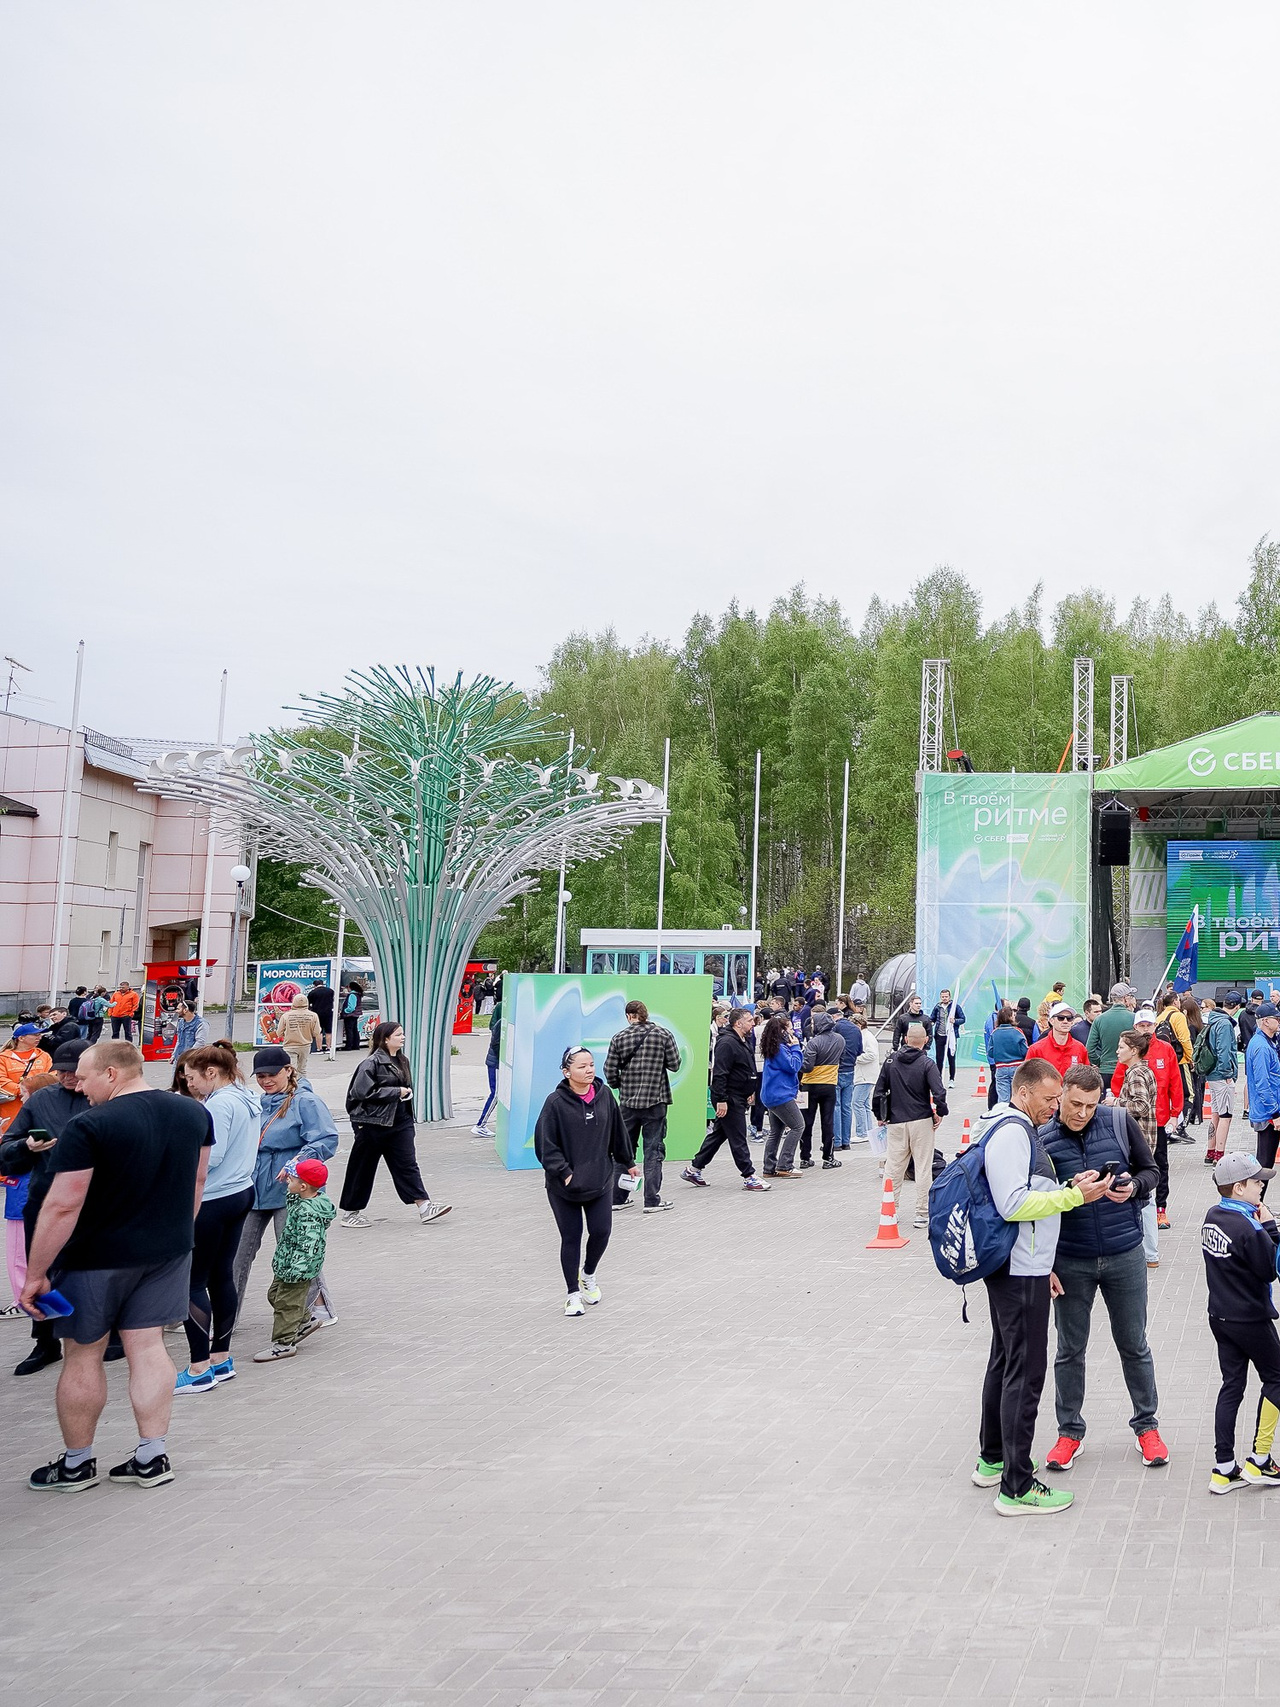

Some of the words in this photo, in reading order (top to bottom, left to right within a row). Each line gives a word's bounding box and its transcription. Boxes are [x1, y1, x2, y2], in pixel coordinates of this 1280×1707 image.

[944, 791, 955, 805] В
[961, 791, 1011, 806] твоём
[974, 806, 1067, 831] ритме
[1211, 912, 1279, 928] твоём
[263, 970, 327, 979] МОРОЖЕНОЕ
